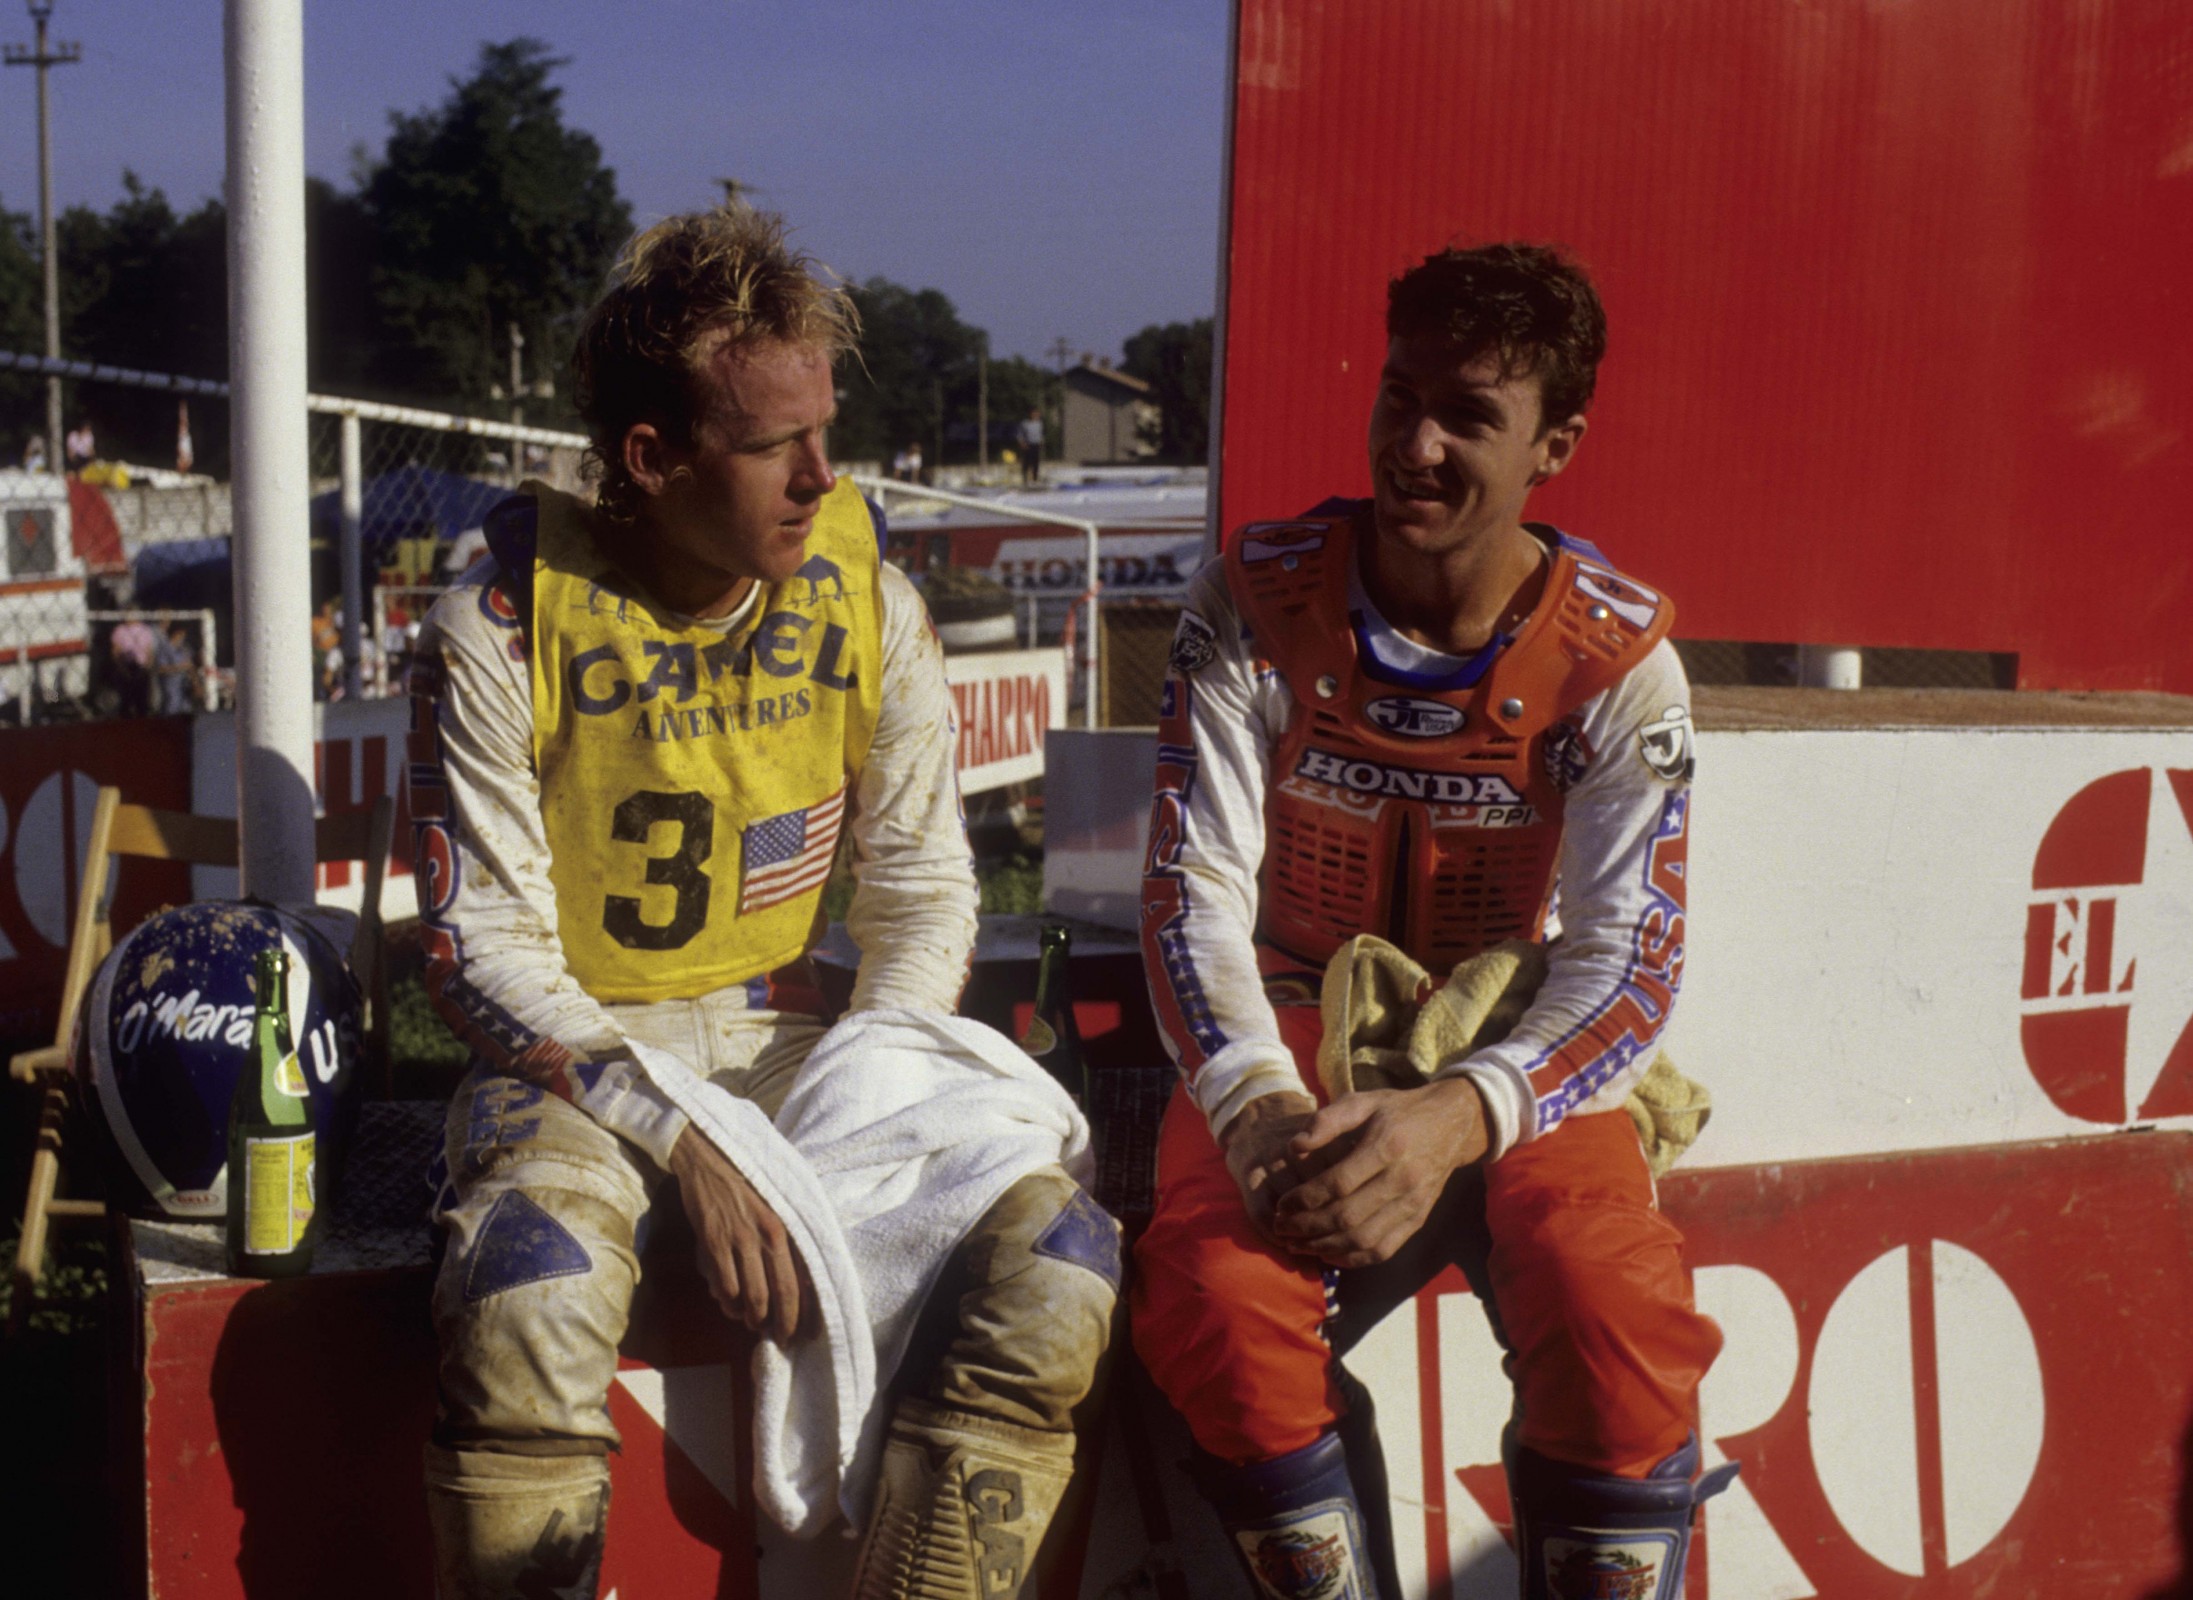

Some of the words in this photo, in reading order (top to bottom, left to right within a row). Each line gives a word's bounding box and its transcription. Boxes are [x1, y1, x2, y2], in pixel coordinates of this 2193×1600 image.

[1001, 555, 1186, 588] HONDA
[568, 611, 858, 716] CAMEL
[633, 687, 812, 743] AVENTURES
[951, 676, 1050, 770] HARRO
[1299, 750, 1521, 803] HONDA
[1483, 808, 1534, 827] PPI
[604, 790, 715, 950] 3
[2021, 896, 2138, 1000] EL
